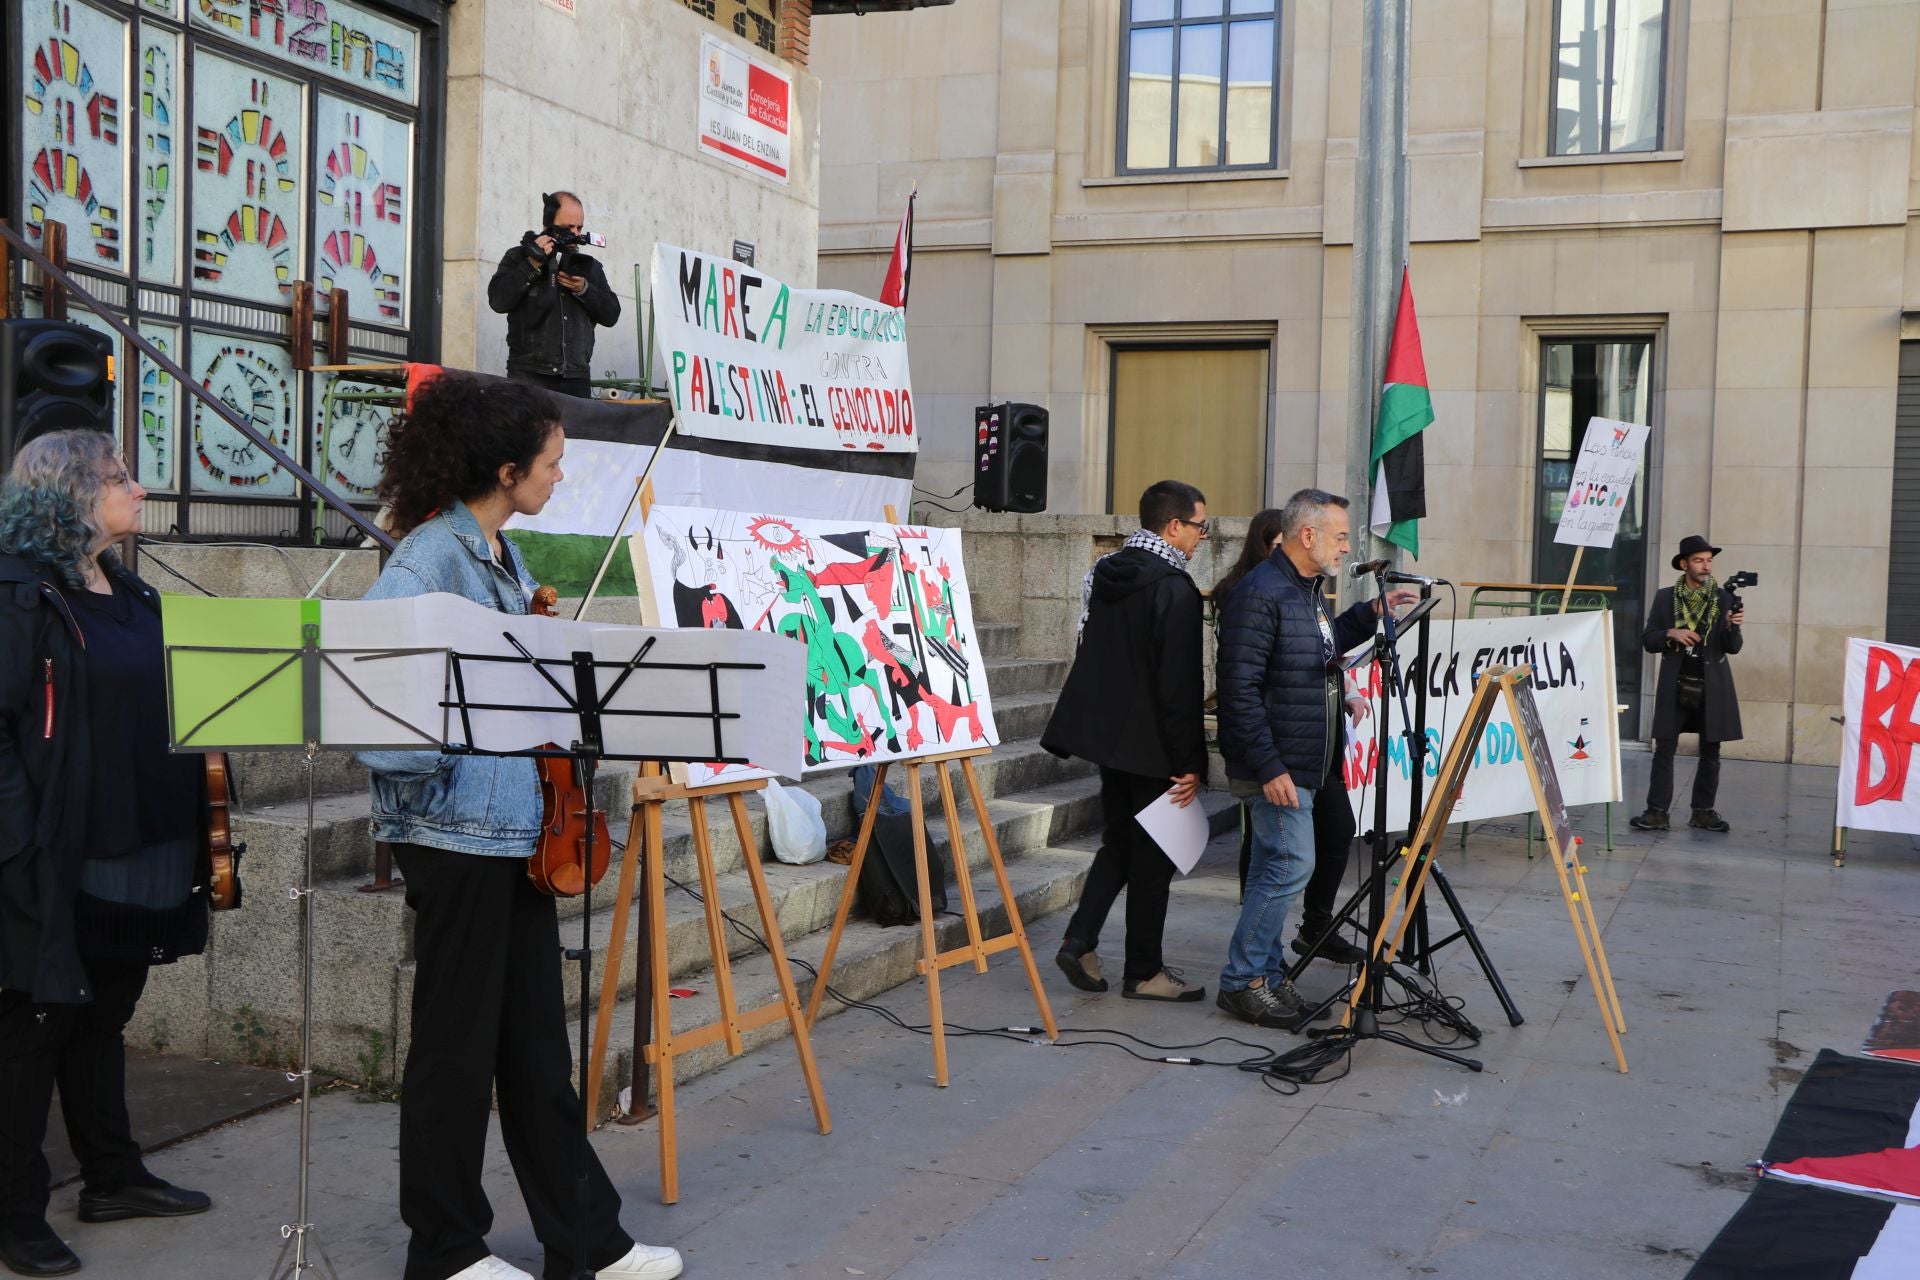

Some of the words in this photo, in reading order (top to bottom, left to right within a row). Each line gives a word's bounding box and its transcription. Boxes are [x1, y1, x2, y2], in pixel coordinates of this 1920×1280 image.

[706, 85, 726, 101] Castilla
[721, 82, 736, 95] Junta
[737, 88, 743, 98] de
[749, 89, 781, 113] Consejería
[749, 103, 758, 115] de
[758, 110, 787, 129] Educación
[710, 119, 721, 136] IES
[723, 126, 741, 144] JUAN
[743, 134, 755, 151] DEL
[756, 141, 781, 161] ENZINA
[803, 302, 824, 333] LA
[819, 351, 888, 381] CONTRA
[800, 383, 825, 428] EL
[827, 386, 914, 437] GENOCIDIO
[1584, 428, 1608, 456] Las
[1575, 469, 1588, 481] en
[1589, 461, 1598, 482] la
[1560, 517, 1574, 529] en
[1577, 509, 1587, 531] la
[1429, 651, 1460, 698] LA
